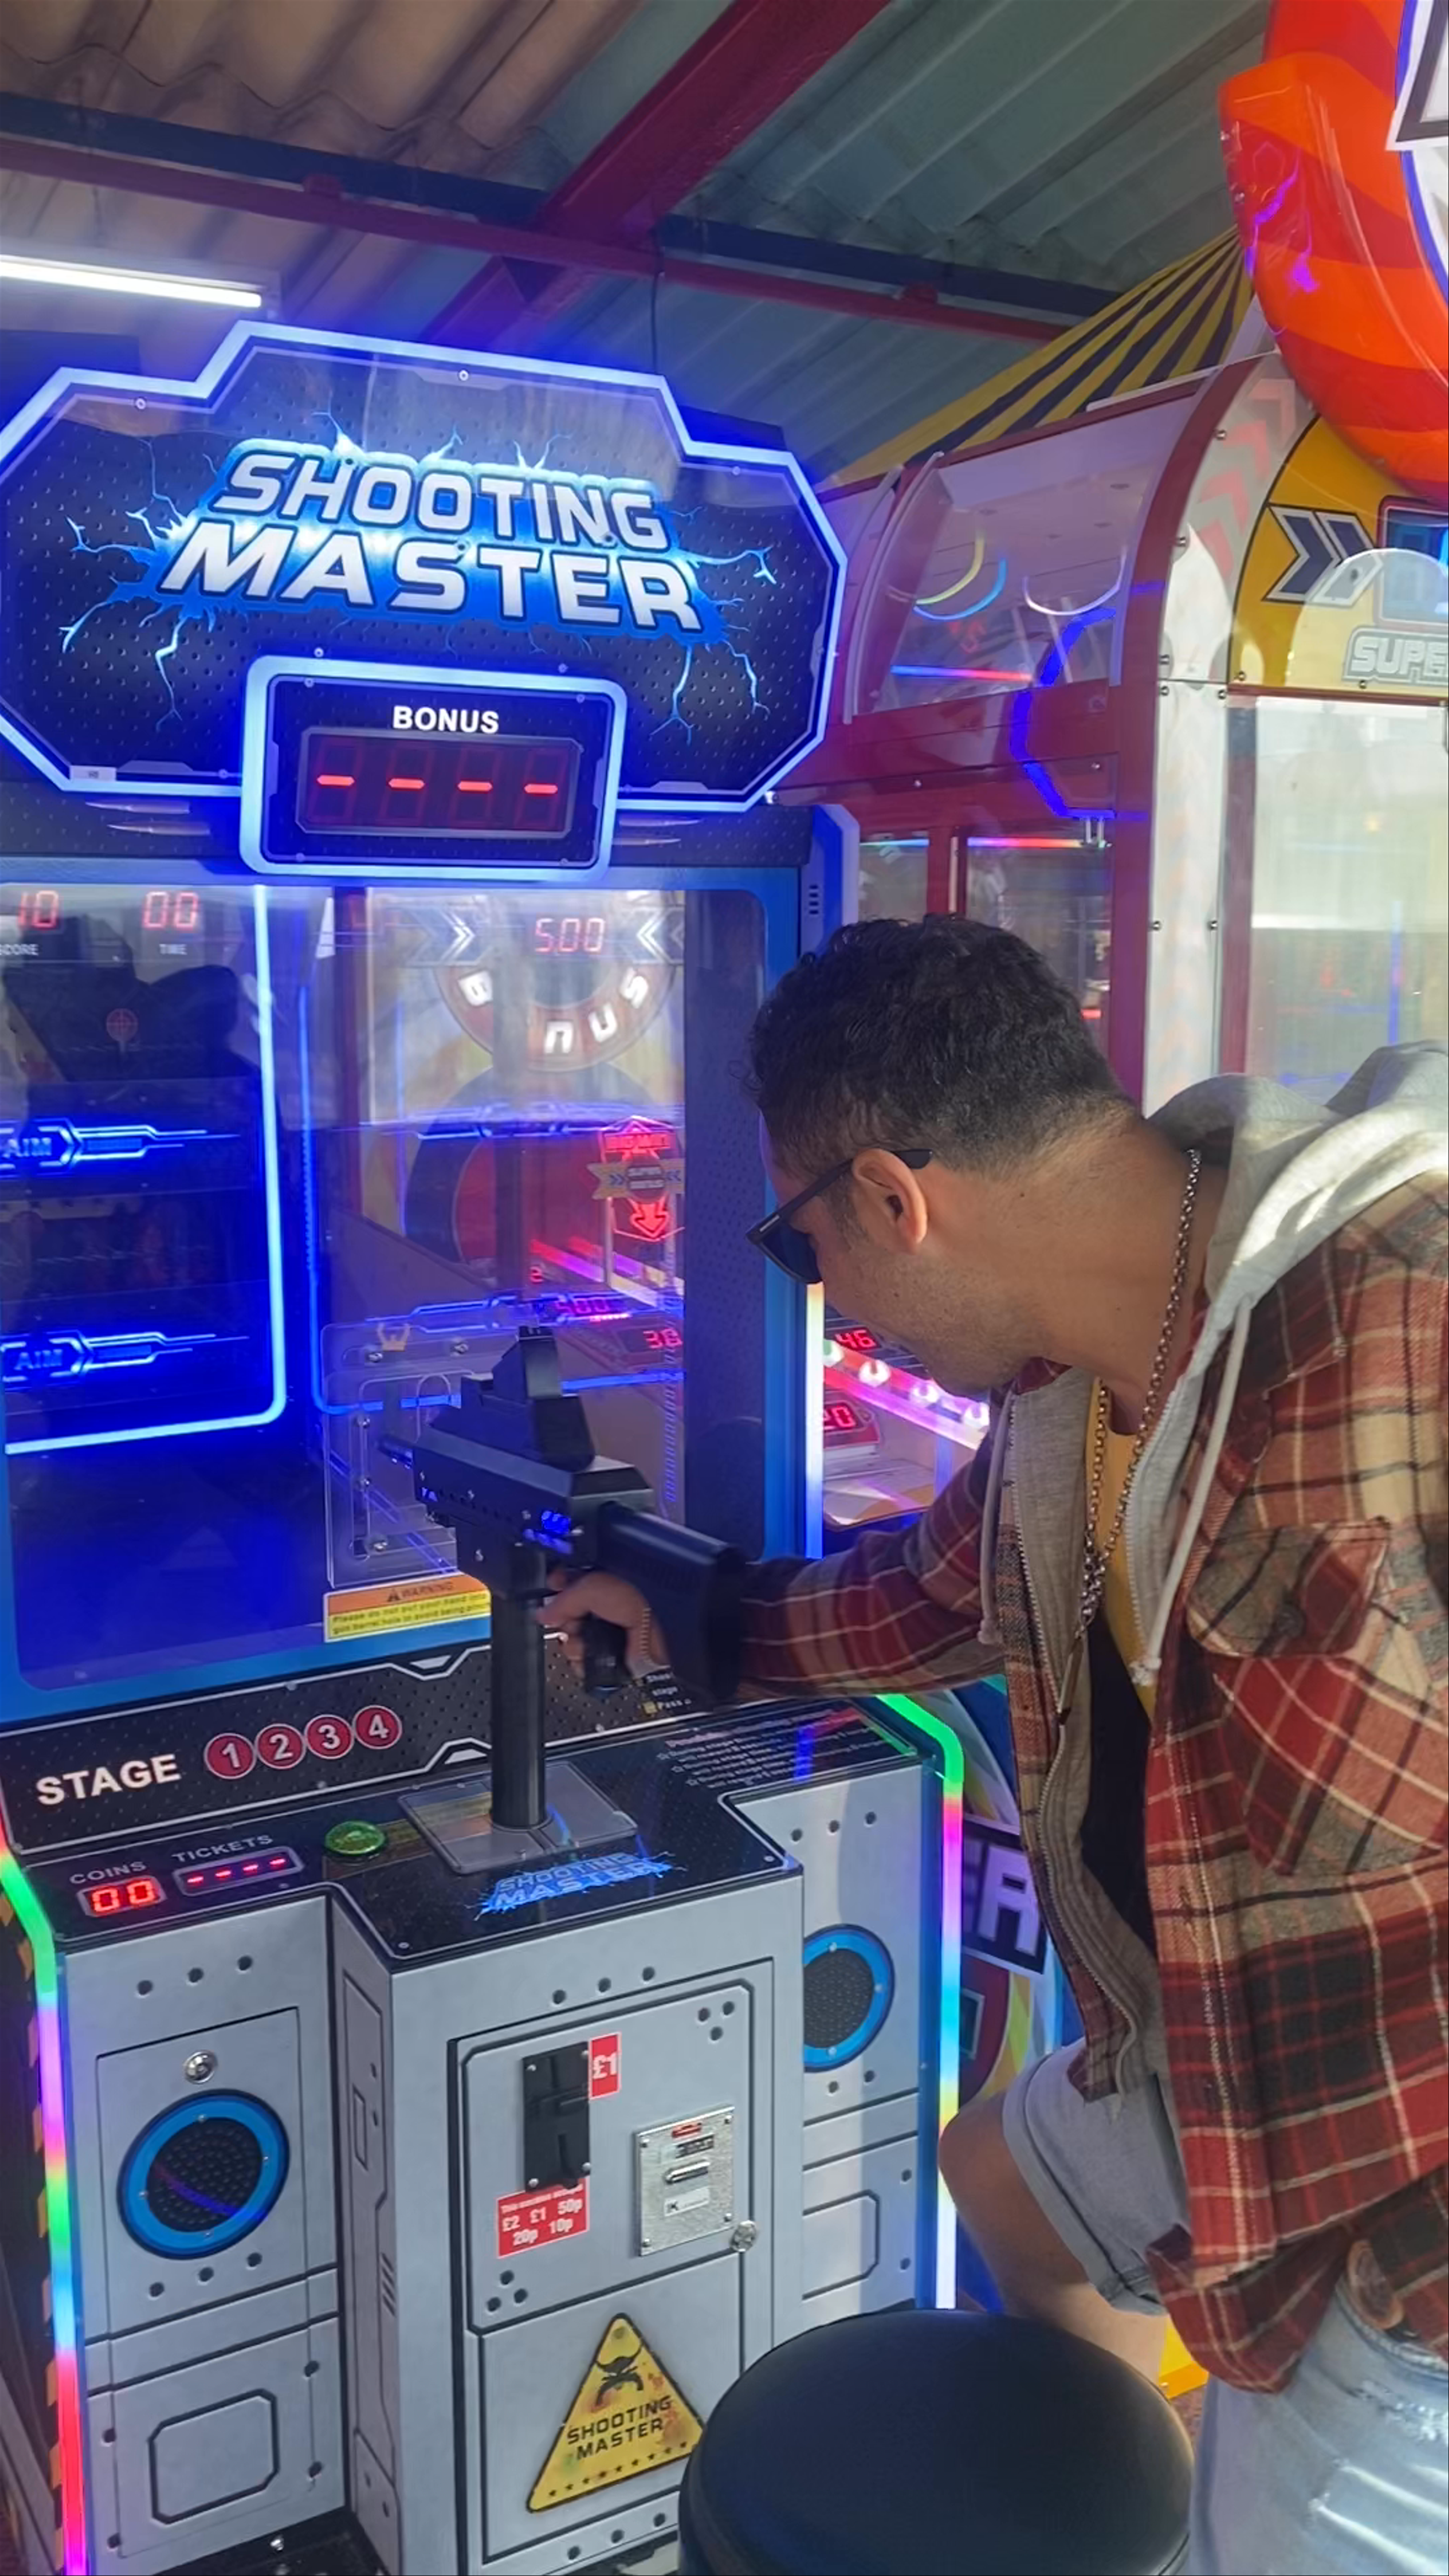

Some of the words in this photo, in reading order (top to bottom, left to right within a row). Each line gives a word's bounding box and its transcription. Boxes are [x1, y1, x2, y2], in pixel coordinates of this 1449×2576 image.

[213, 454, 668, 550] SHOOTING
[161, 521, 701, 629] MASTER
[393, 706, 499, 733] BONUS
[143, 891, 199, 930] 00
[535, 918, 605, 952] 500
[35, 1754, 181, 1806] STAGE
[221, 1743, 240, 1769] 1
[269, 1733, 294, 1761] 2
[318, 1724, 341, 1750] 3
[368, 1714, 388, 1738] 4
[171, 1835, 273, 1862] TICKETS
[69, 1861, 147, 1884] COINS
[496, 1862, 652, 1905] MASTER
[498, 1853, 634, 1891] SHOOTING
[91, 1879, 156, 1913] 00
[592, 2052, 617, 2080] £1
[502, 2215, 520, 2232] £2
[530, 2207, 546, 2224] £1
[557, 2199, 583, 2215] 50p
[512, 2229, 538, 2246] 20p
[548, 2218, 573, 2235] 10p
[567, 2395, 672, 2445] SHOOTING
[577, 2417, 663, 2460] MASTER
